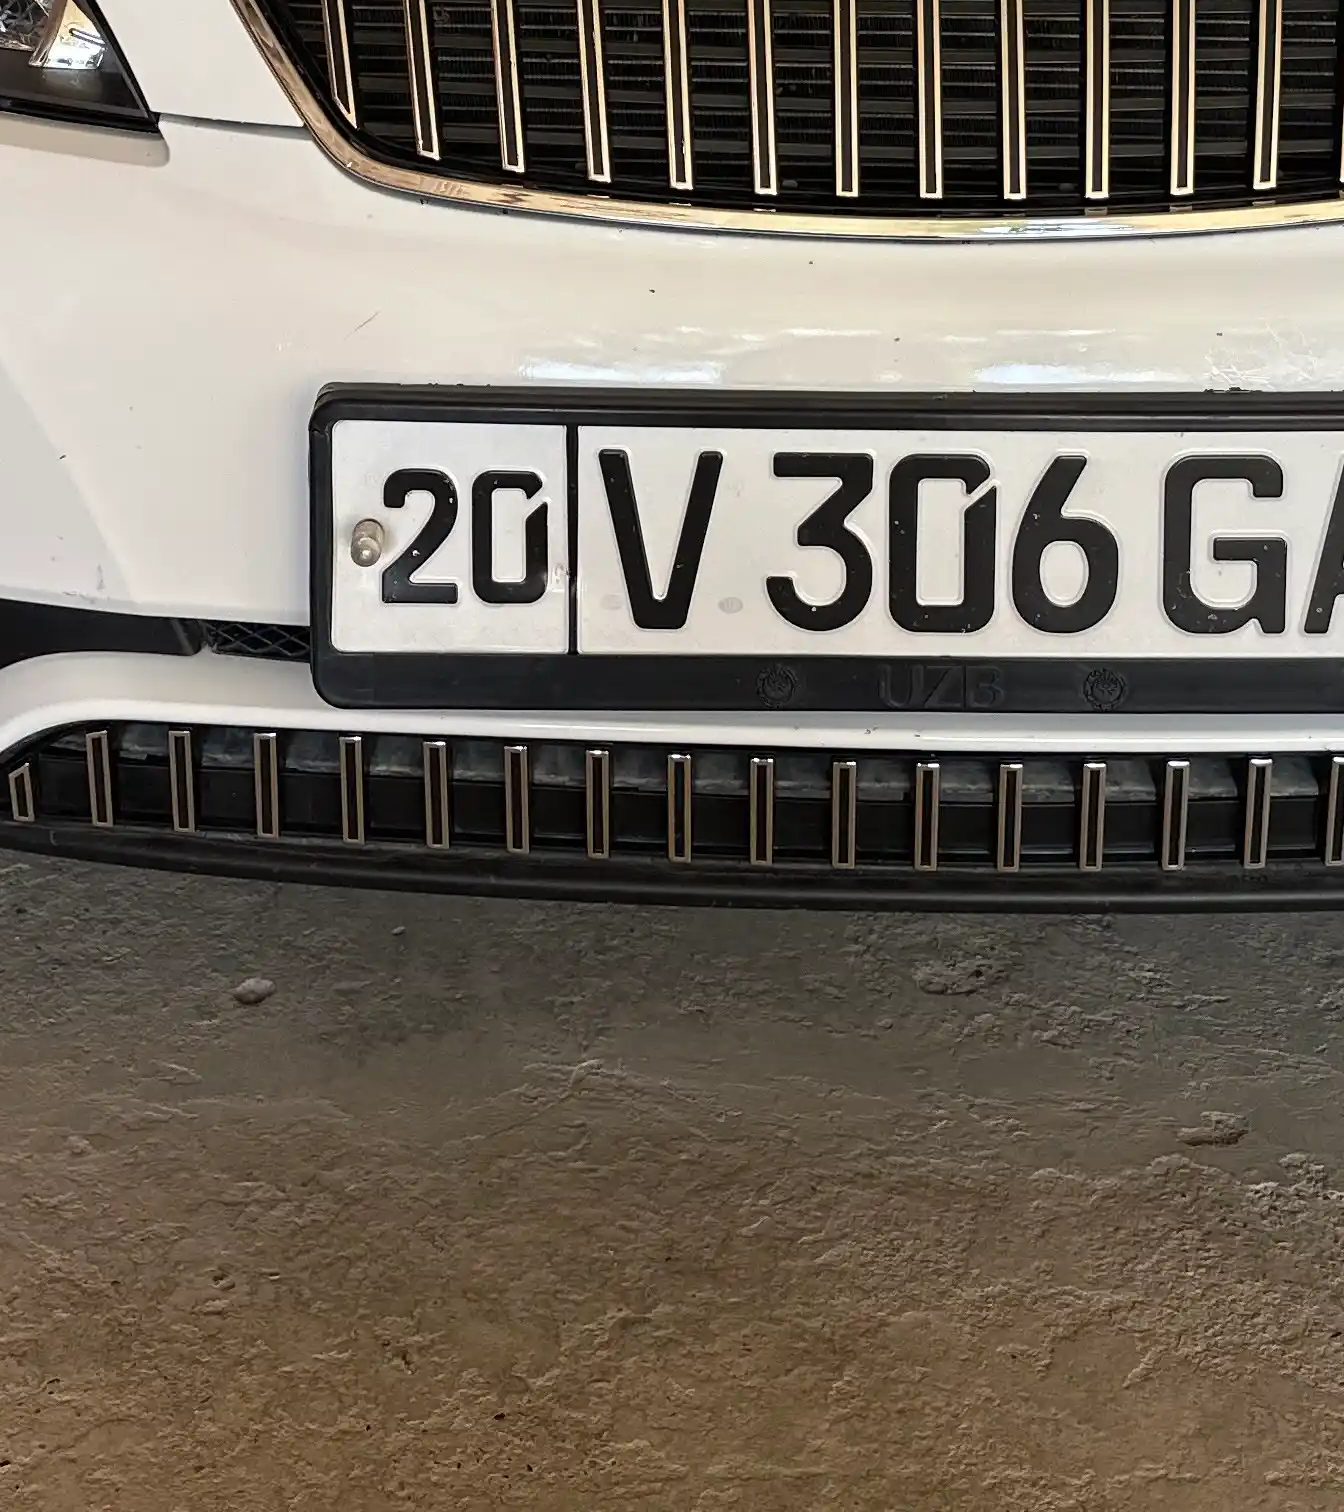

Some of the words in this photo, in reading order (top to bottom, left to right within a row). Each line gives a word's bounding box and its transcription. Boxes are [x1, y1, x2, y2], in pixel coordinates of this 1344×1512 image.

[382, 468, 548, 604] 20
[598, 448, 724, 630] V
[765, 451, 1120, 634] 306
[878, 663, 1006, 710] UZB
